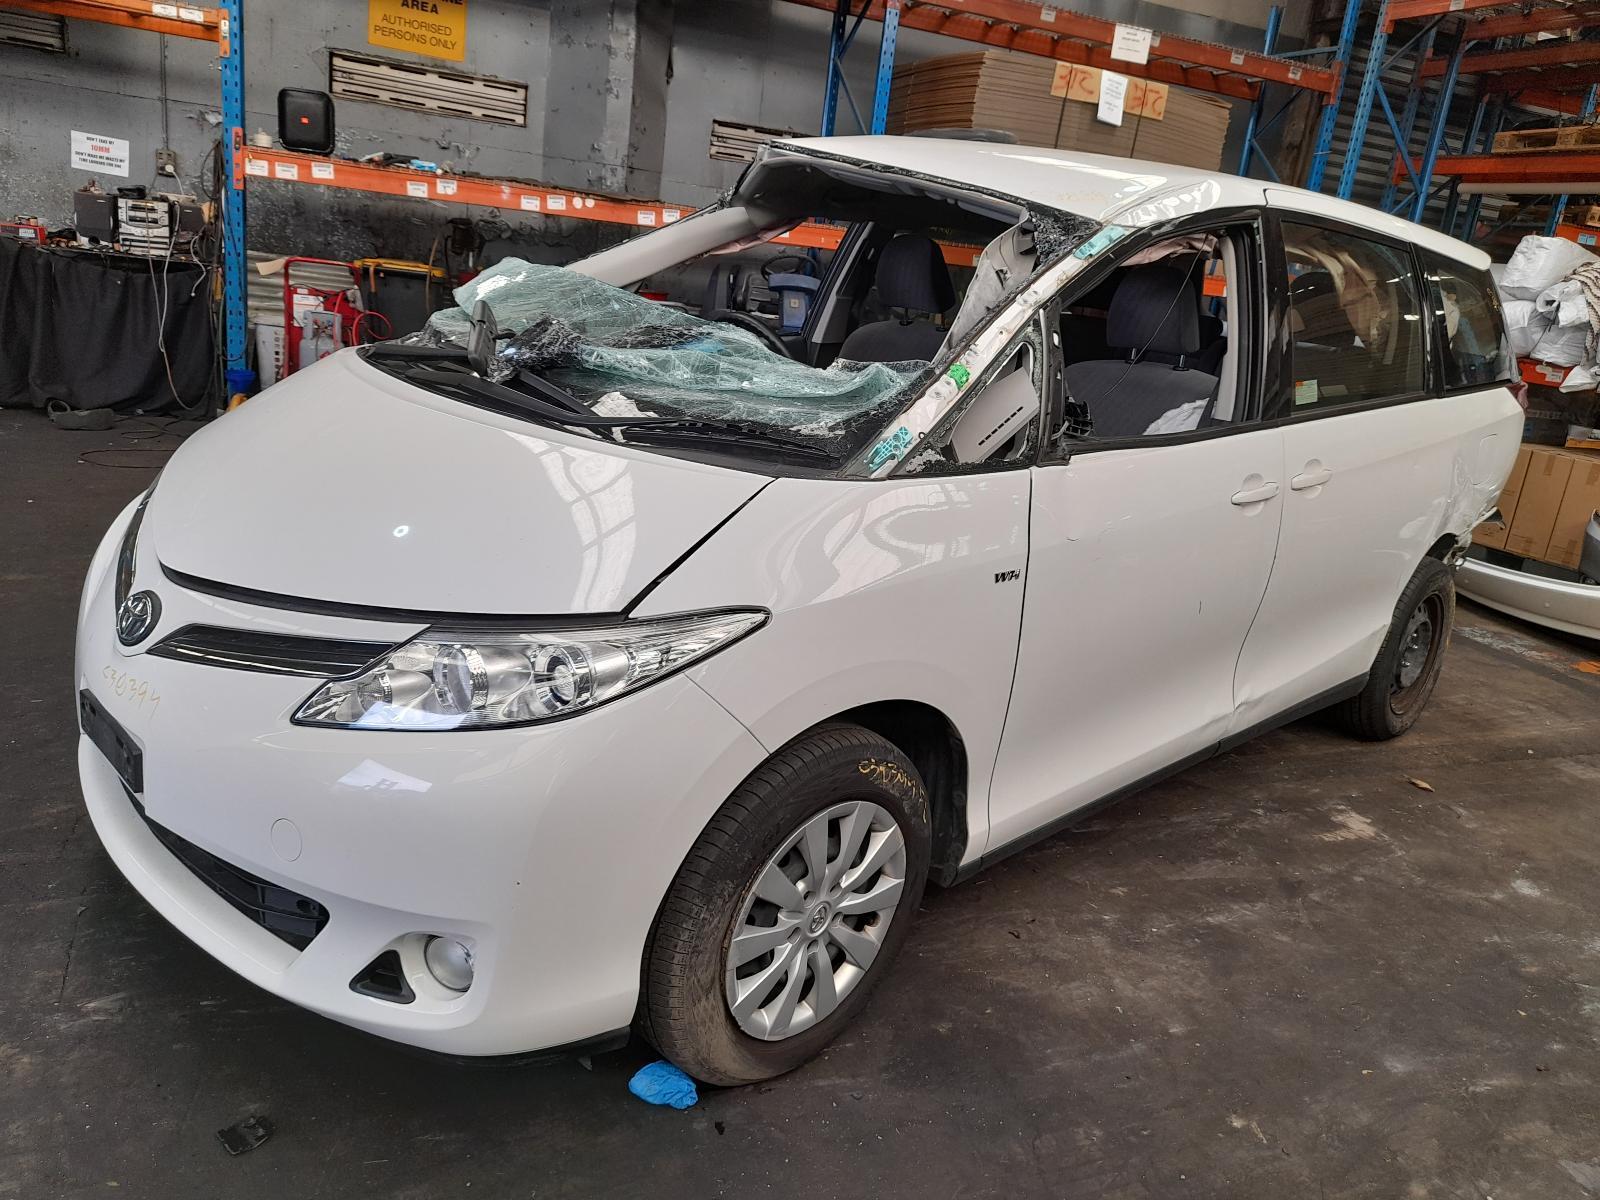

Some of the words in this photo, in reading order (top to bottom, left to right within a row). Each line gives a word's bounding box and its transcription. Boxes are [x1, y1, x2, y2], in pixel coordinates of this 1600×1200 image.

[401, 0, 439, 15] AREA
[382, 14, 452, 36] AUTHORISED
[374, 25, 427, 44] PERSONS
[429, 36, 457, 50] ONLY
